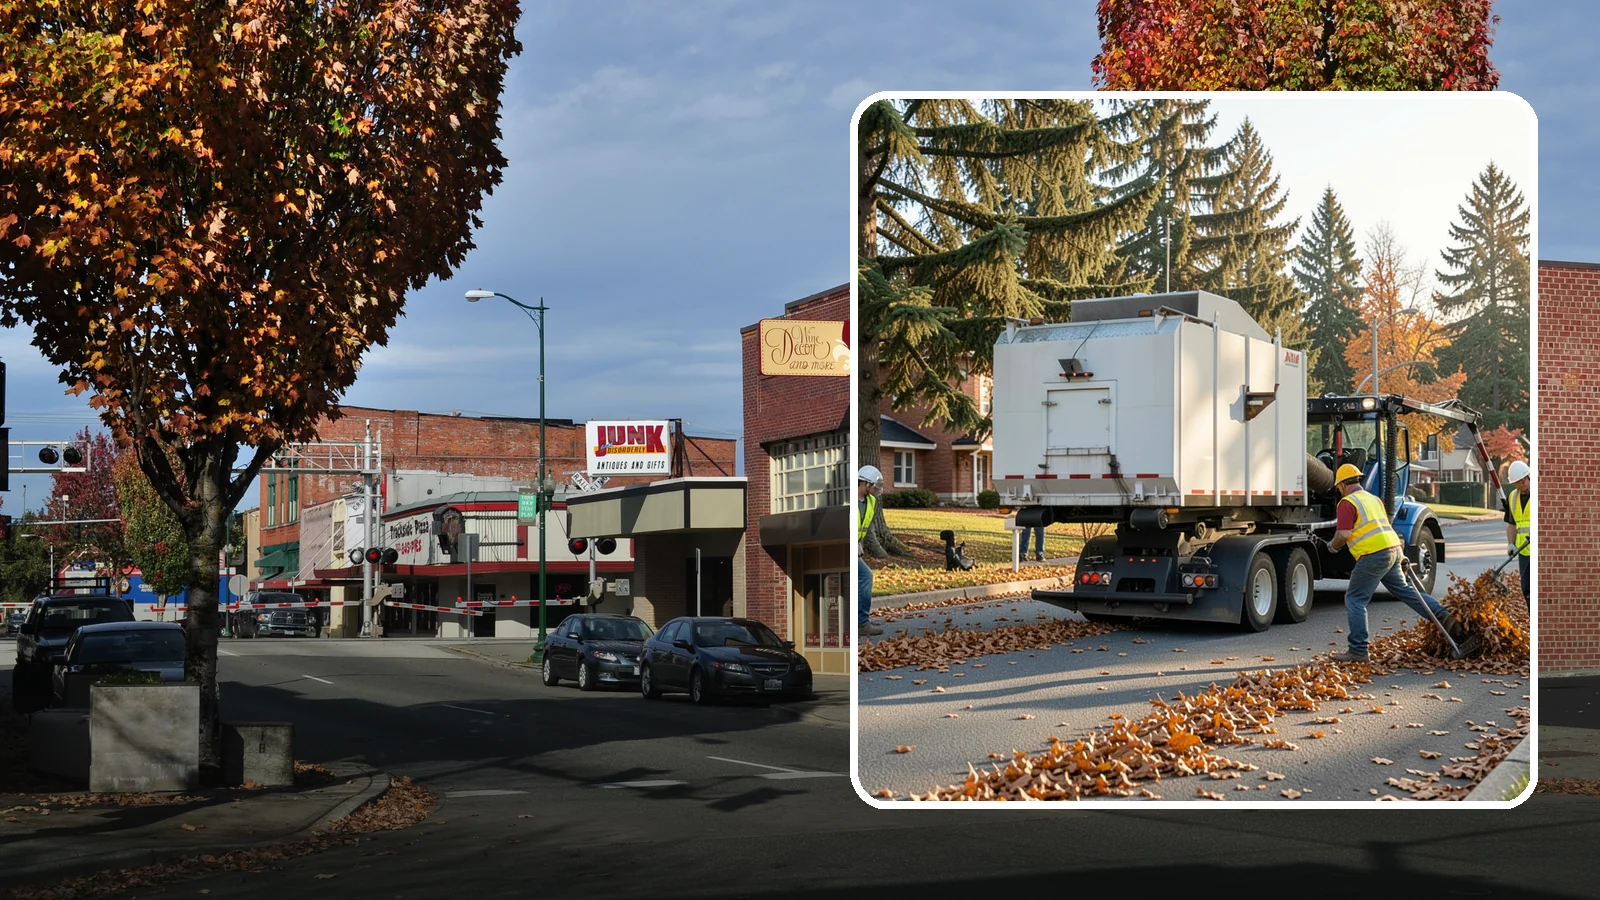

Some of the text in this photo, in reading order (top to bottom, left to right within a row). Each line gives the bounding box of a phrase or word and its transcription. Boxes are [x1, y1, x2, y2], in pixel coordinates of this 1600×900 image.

[595, 425, 665, 457] JUNK
[607, 446, 646, 454] DISORDERLY
[596, 460, 665, 470] ANTIQUES AND GIFTS
[390, 519, 429, 540] Trackside Pizza
